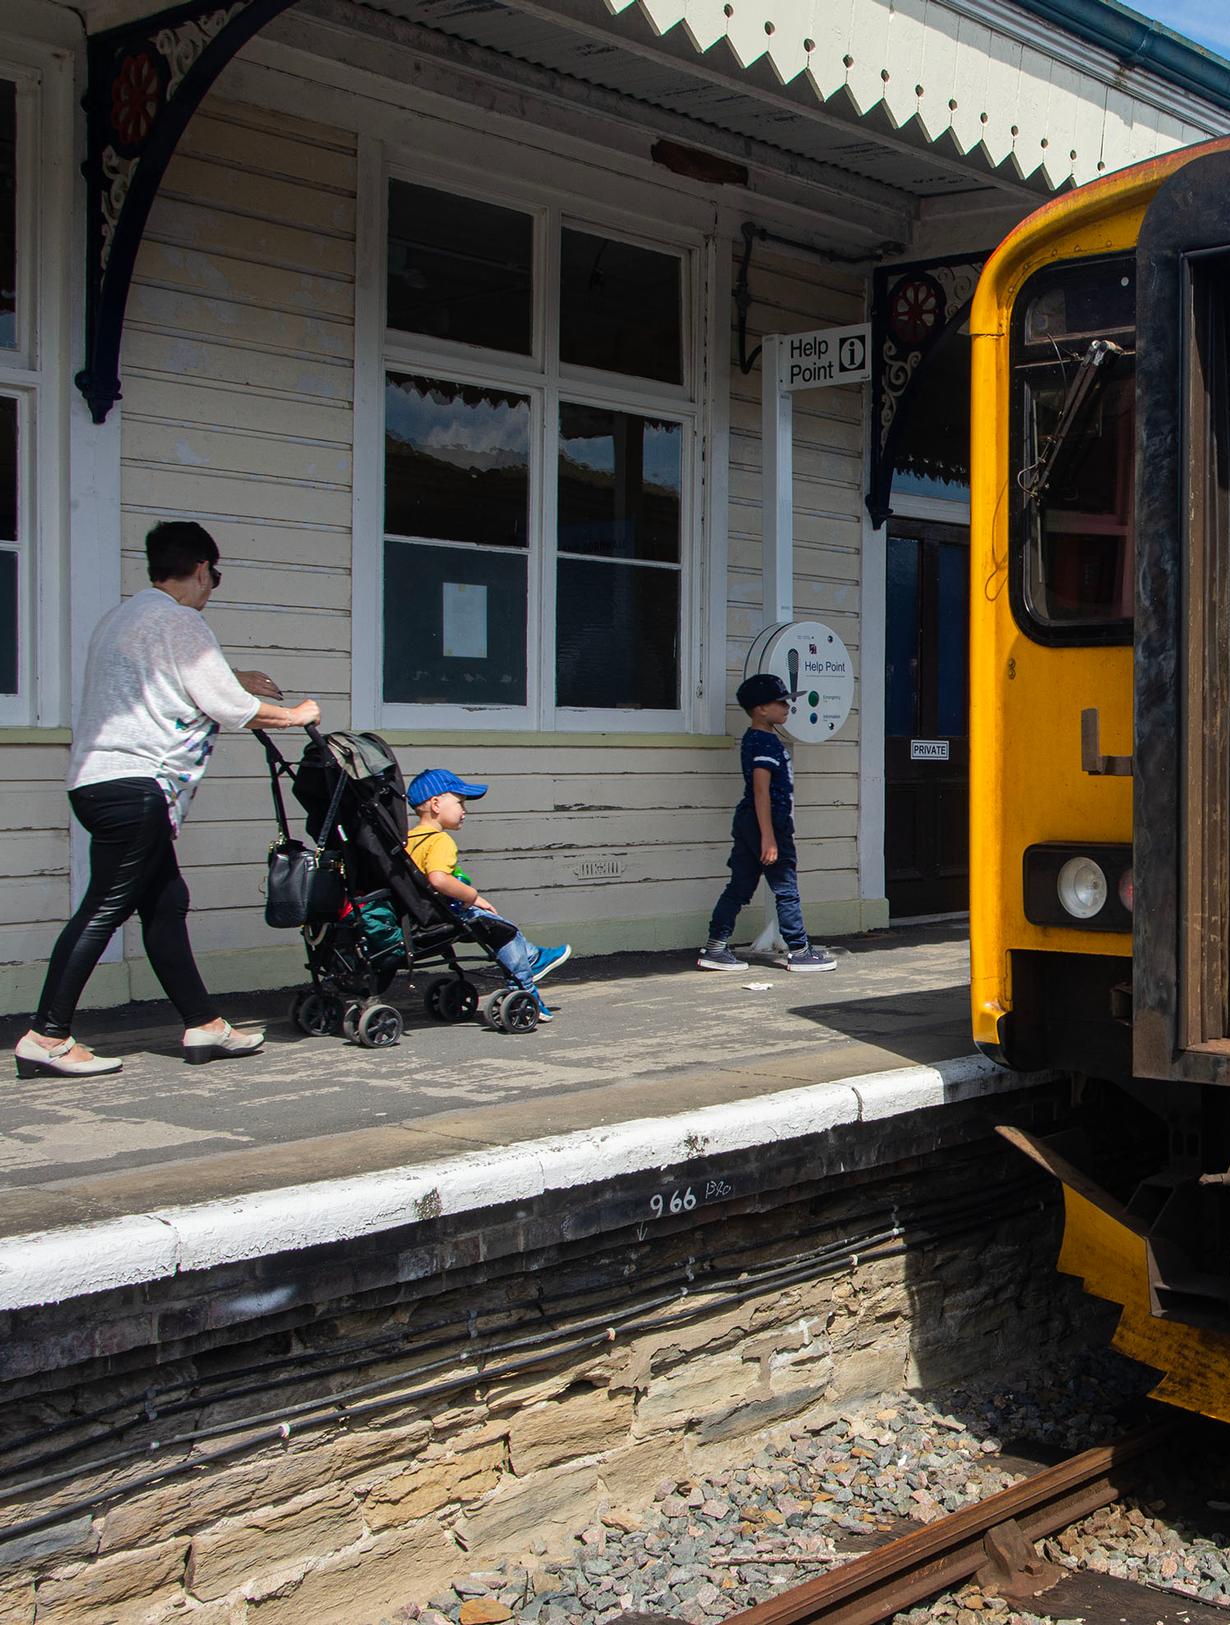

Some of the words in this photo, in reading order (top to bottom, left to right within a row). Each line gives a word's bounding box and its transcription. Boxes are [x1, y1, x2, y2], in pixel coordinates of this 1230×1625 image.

[790, 336, 829, 360] Help
[790, 361, 834, 385] Point
[804, 660, 824, 674] Help
[825, 660, 846, 673] Point
[914, 745, 946, 755] PRIVATE
[650, 1186, 697, 1220] 966
